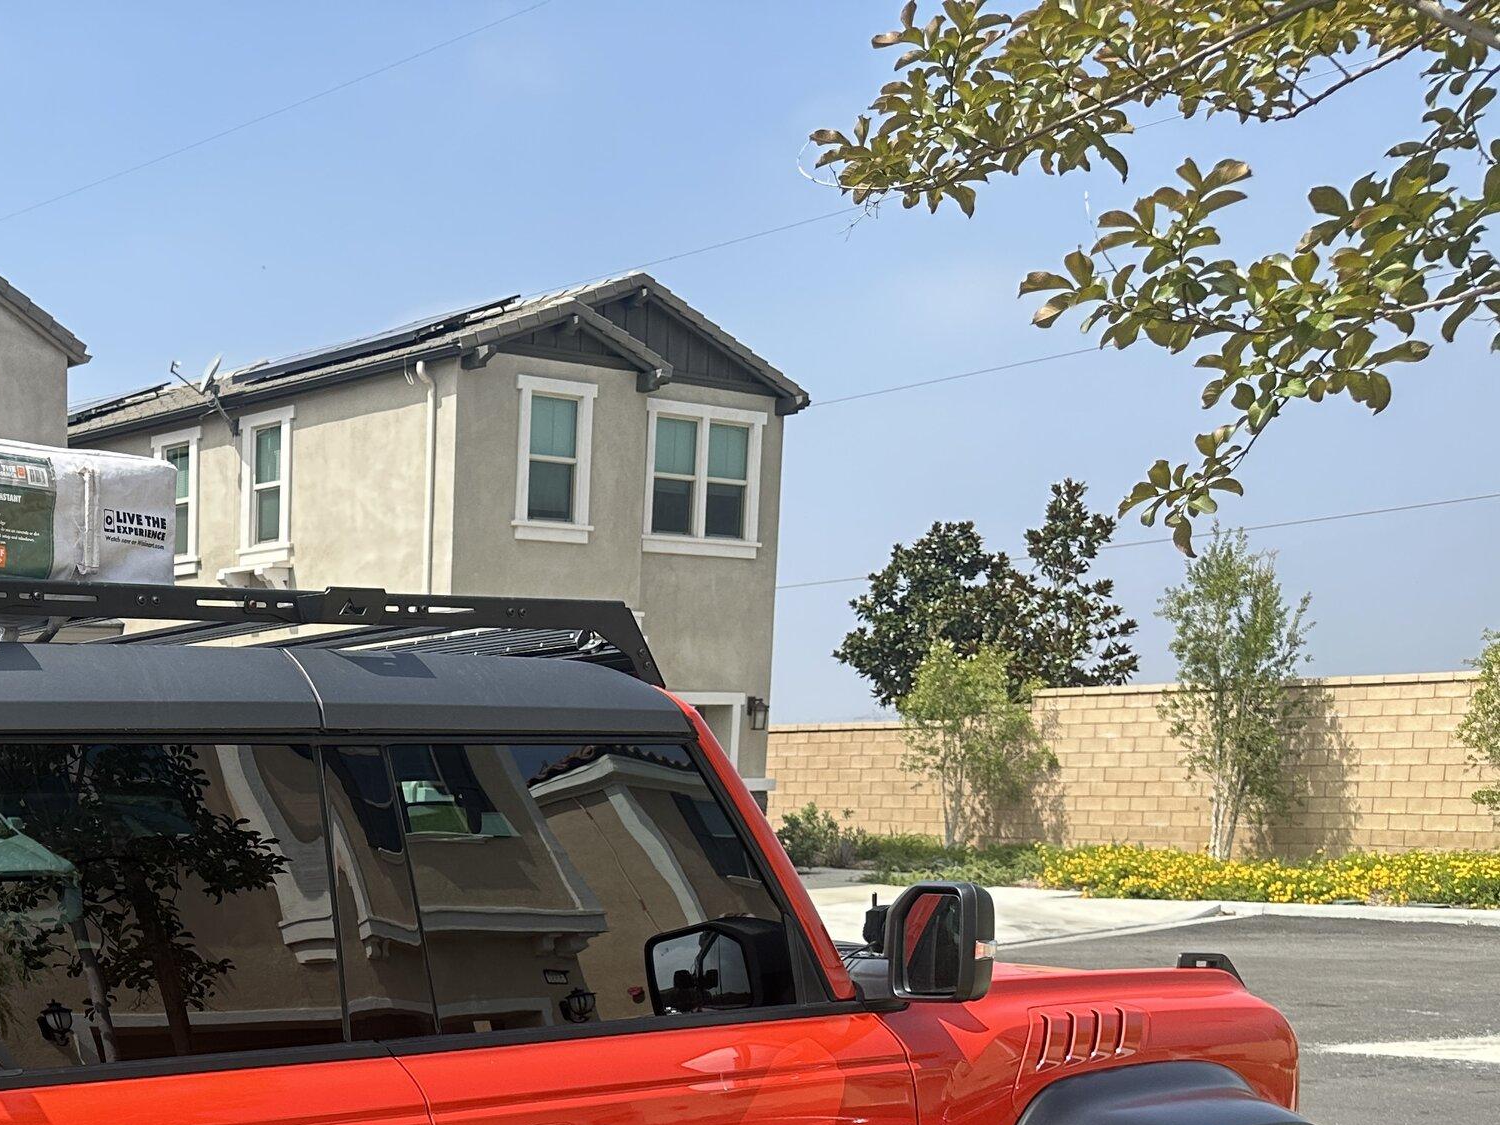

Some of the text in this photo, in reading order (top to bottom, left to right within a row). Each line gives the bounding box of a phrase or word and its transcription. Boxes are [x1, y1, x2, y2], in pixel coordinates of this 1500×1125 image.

[116, 511, 167, 529] LIVE THE
[117, 526, 166, 541] EXPERIENCE
